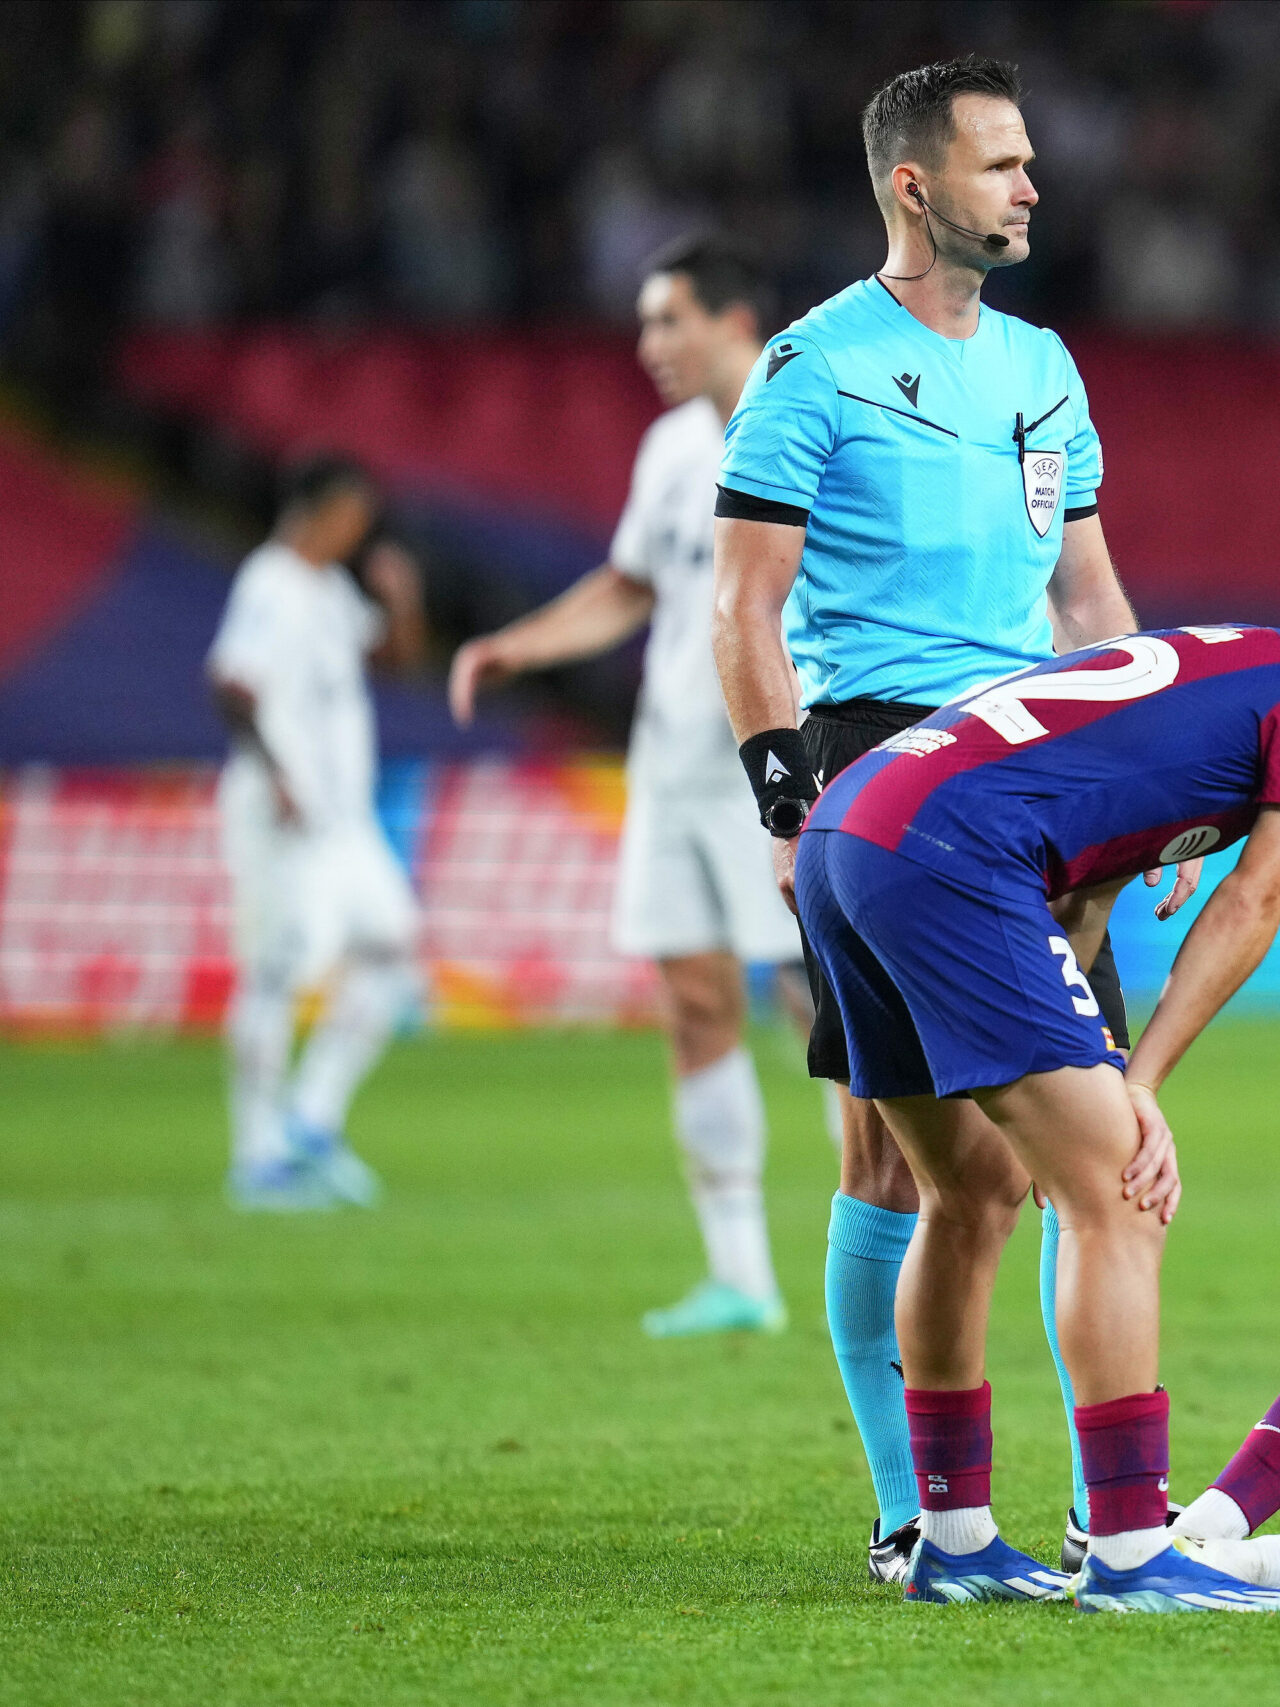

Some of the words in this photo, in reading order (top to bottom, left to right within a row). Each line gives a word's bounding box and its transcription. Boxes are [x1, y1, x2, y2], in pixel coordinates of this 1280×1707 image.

[1034, 461, 1058, 476] UEFA
[1035, 487, 1055, 496] MATCH
[1031, 499, 1055, 509] OFFICIAL
[938, 634, 1180, 744] 2
